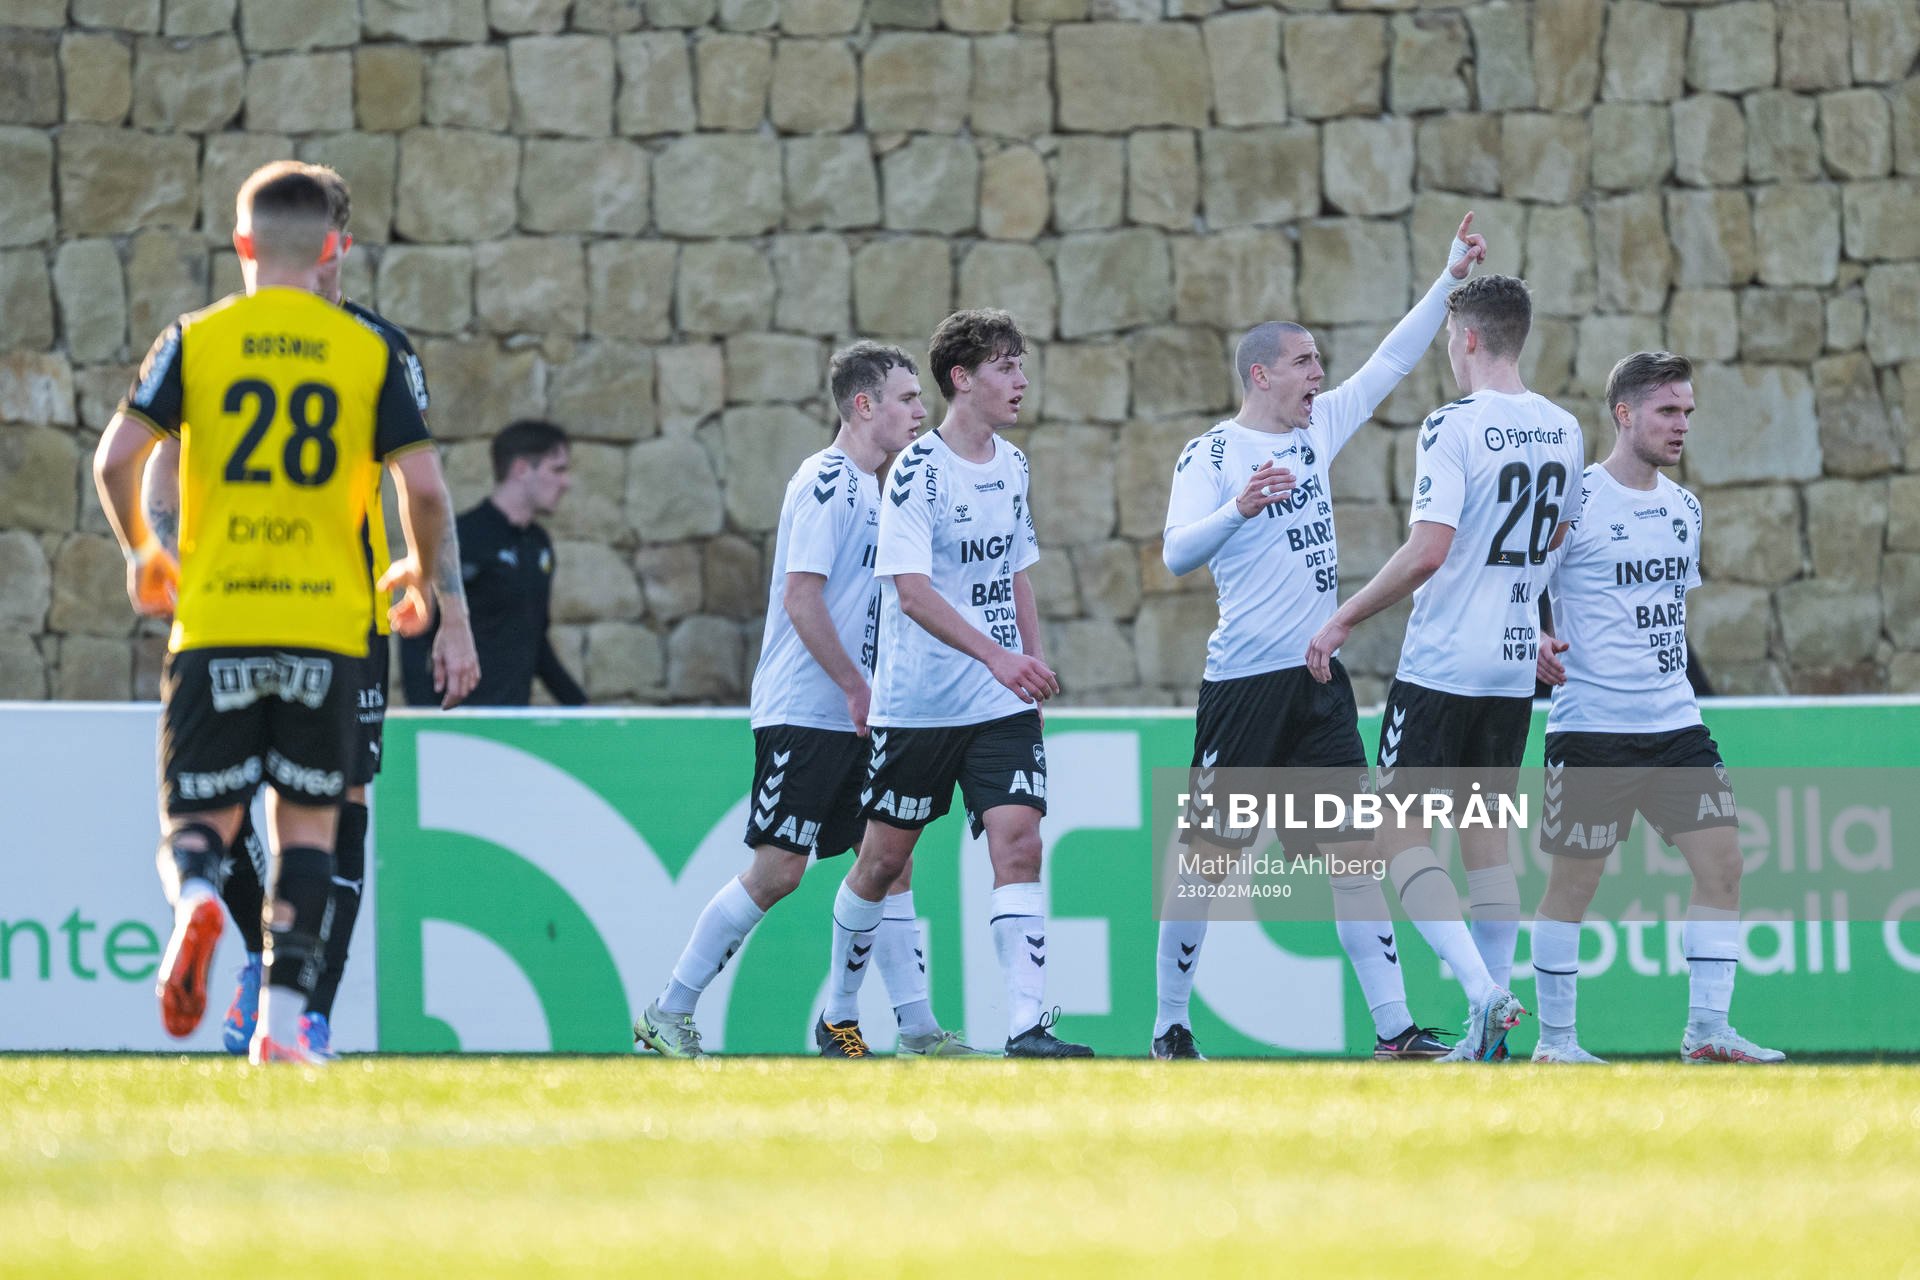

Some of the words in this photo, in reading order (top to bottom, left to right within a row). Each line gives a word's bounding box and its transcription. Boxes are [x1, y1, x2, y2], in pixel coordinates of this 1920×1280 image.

[221, 377, 341, 488] 28
[1484, 460, 1566, 568] 26
[1305, 550, 1327, 569] DET
[1616, 556, 1690, 586] INGEN
[1636, 602, 1685, 629] BARE
[1649, 632, 1672, 648] DET
[1657, 647, 1686, 674] SER
